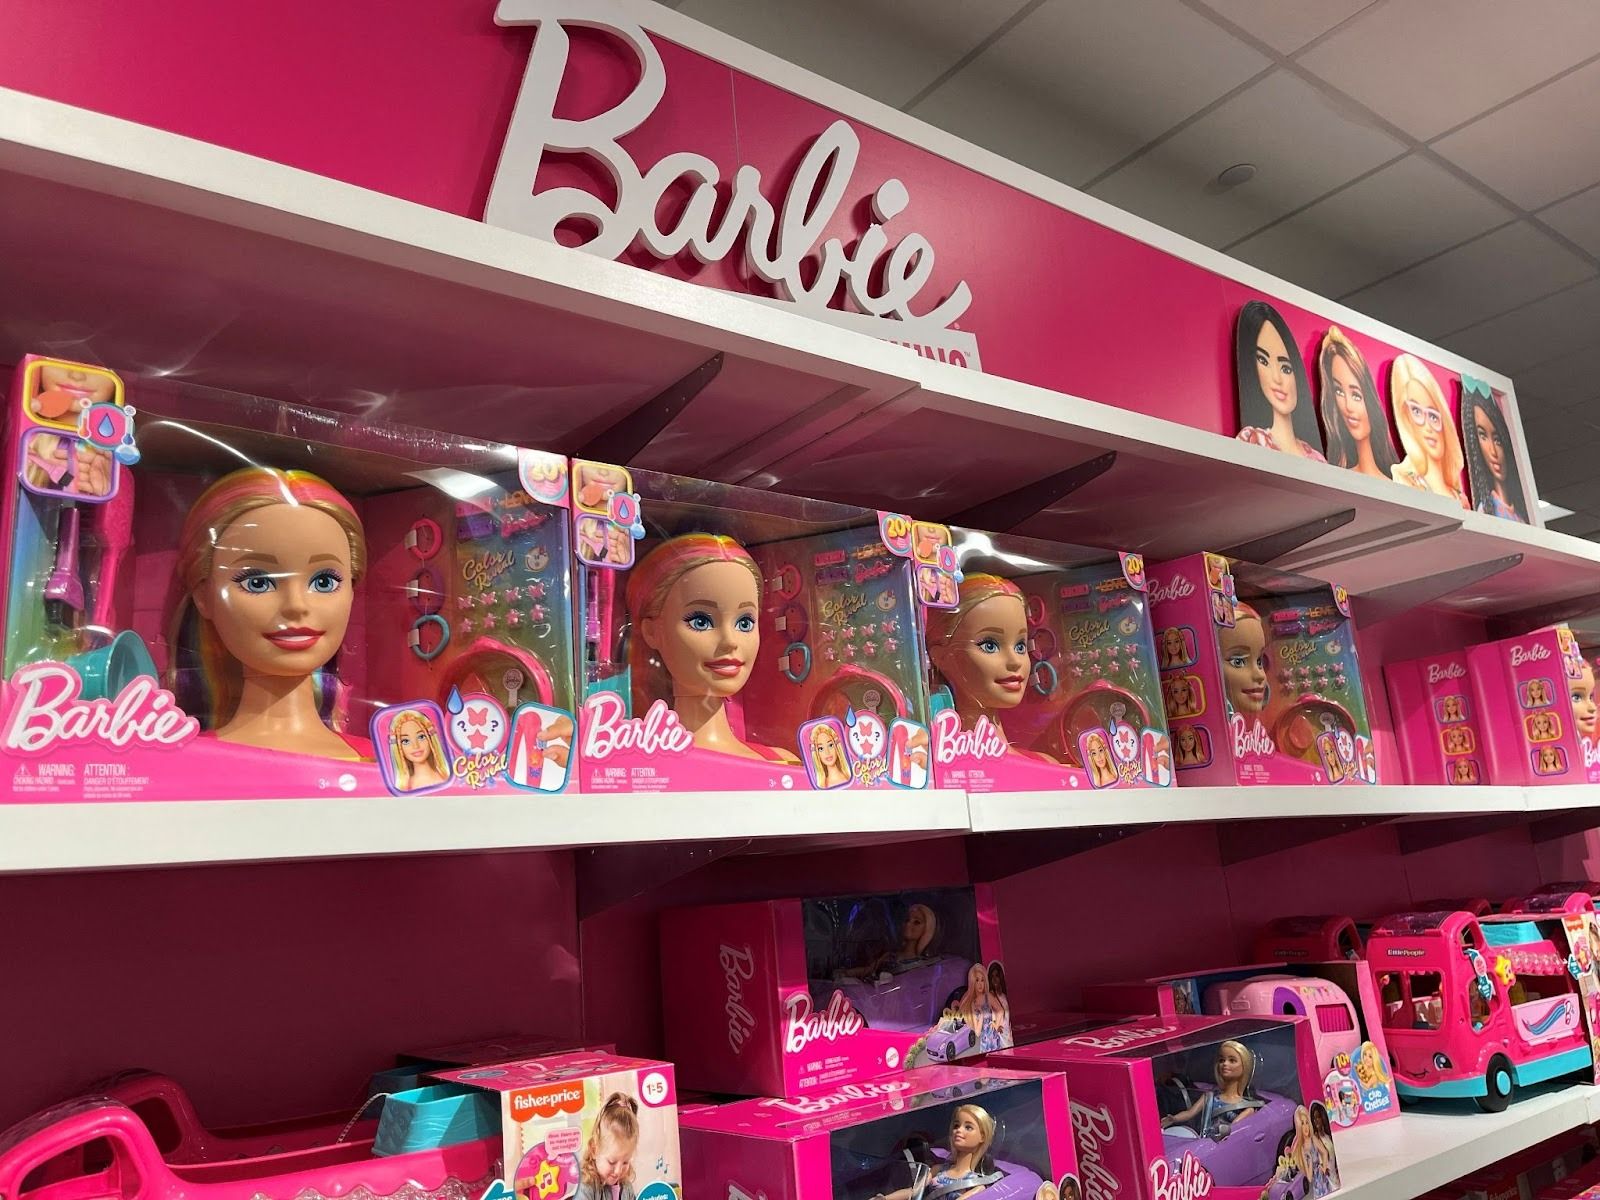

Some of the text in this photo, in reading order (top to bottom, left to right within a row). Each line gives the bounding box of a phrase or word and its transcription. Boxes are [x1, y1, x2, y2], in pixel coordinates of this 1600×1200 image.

[484, 0, 972, 319] Barbie
[463, 551, 504, 581] Color
[823, 592, 859, 619] Color
[1147, 575, 1195, 606] Barbie
[1069, 620, 1101, 641] Color
[1510, 643, 1551, 666] Barbie
[1428, 663, 1466, 683] Barbie
[7, 667, 195, 751] Barbie
[585, 694, 693, 759] Barbie
[936, 712, 1007, 763] Barbie
[1231, 712, 1274, 759] Barbie
[453, 752, 499, 777] Color
[467, 753, 508, 790] Reveal
[852, 757, 883, 778] Color
[320, 779, 330, 789] 3+
[719, 943, 757, 1055] Barbie
[785, 992, 862, 1053] Barbie
[1065, 1026, 1177, 1049] Barbie
[514, 1088, 581, 1110] fisher-price
[758, 1081, 911, 1114] Barbie
[1364, 1096, 1390, 1112] Chelsea
[1368, 1089, 1382, 1101] Club
[1151, 1151, 1211, 1200] Barbie
